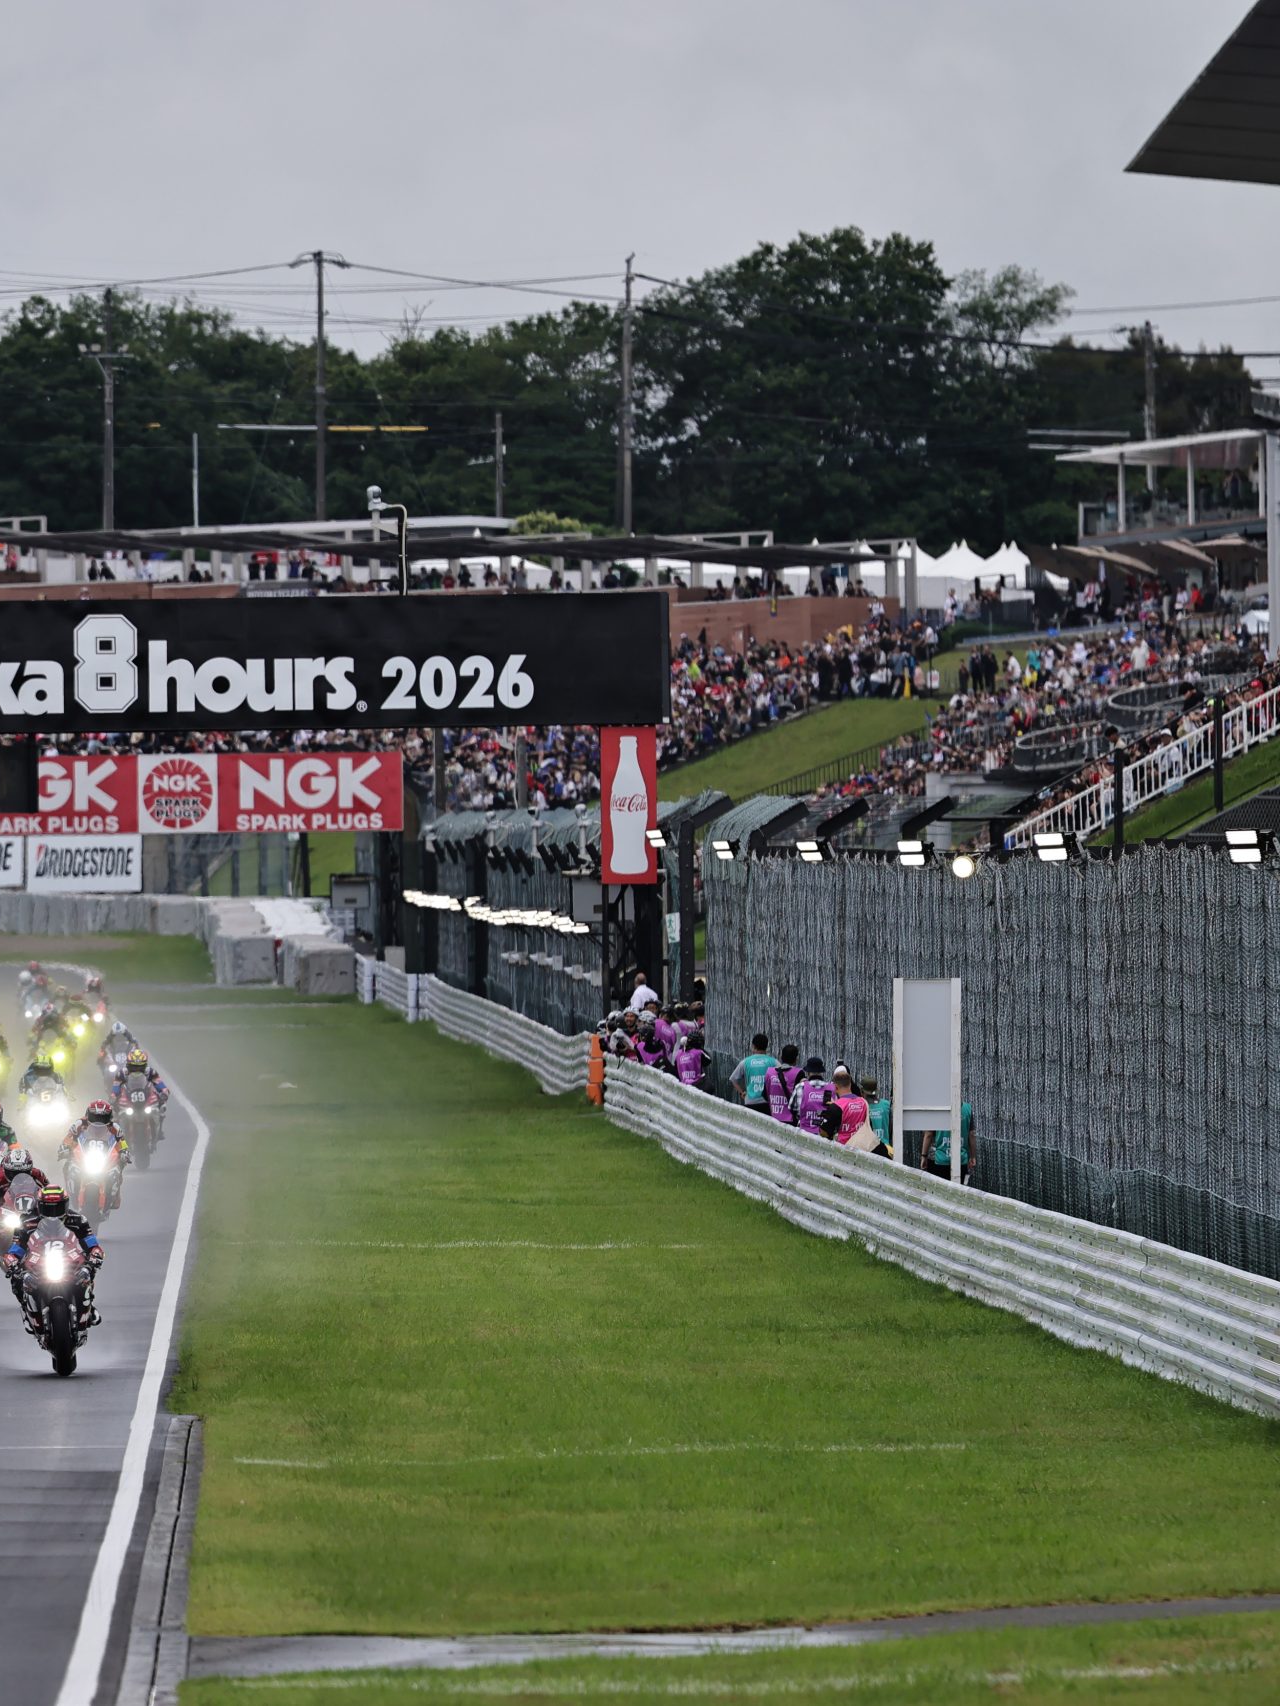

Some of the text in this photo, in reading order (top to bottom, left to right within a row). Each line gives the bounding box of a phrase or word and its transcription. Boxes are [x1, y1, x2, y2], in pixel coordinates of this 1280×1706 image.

[73, 613, 139, 713] 8
[148, 639, 358, 713] hours
[380, 654, 535, 710] 2026
[38, 758, 118, 813] GK
[152, 773, 201, 793] NGK
[239, 755, 382, 810] NGK
[154, 798, 200, 807] SPARK
[155, 809, 201, 819] PLUGS
[236, 812, 383, 831] SPARK PLUGS
[47, 815, 119, 833] PLUGS
[35, 844, 134, 878] BRIDGESTONE
[16, 1197, 34, 1211] 17
[44, 1240, 65, 1256] 12
